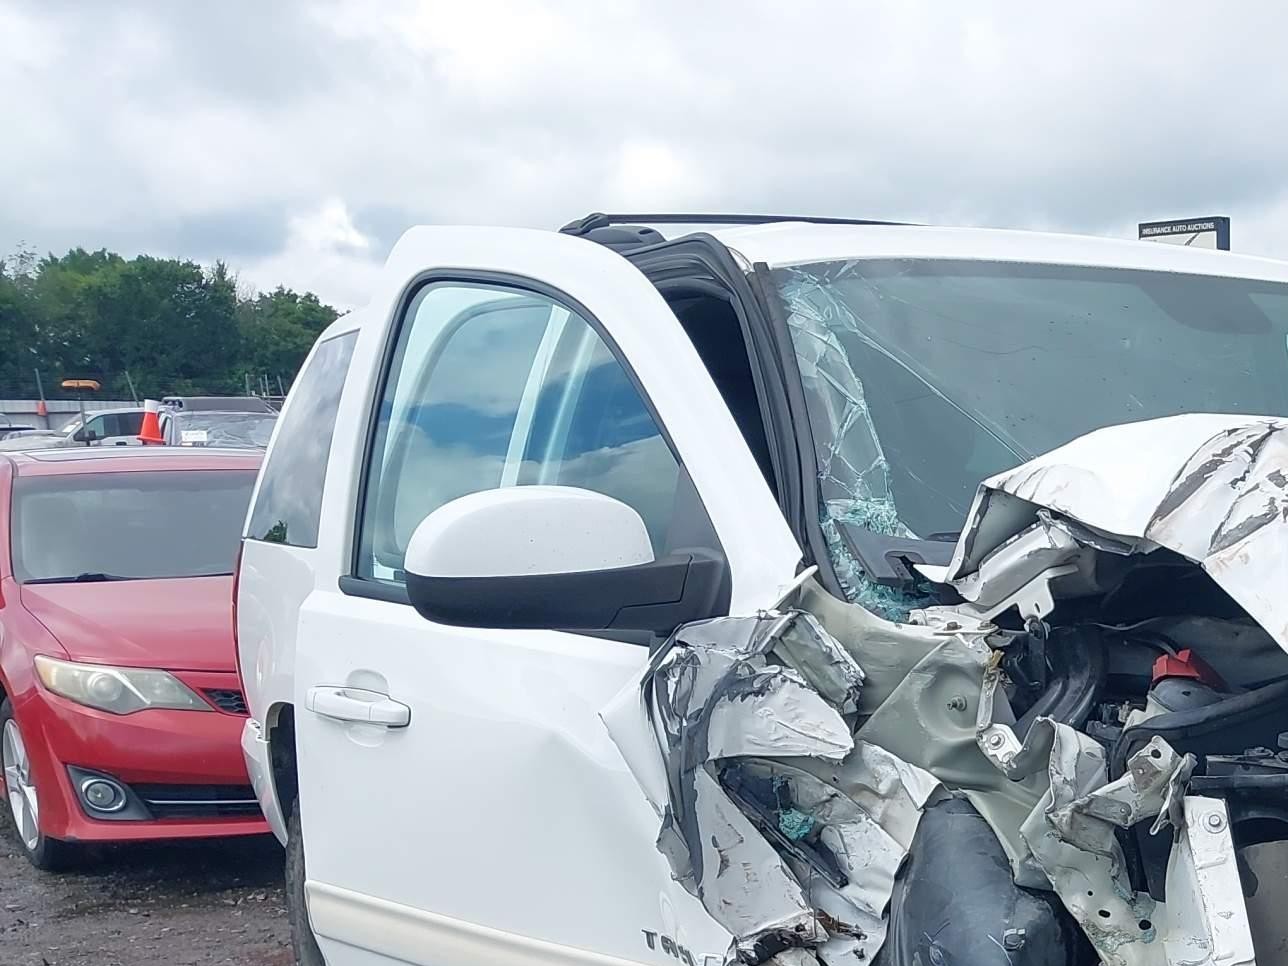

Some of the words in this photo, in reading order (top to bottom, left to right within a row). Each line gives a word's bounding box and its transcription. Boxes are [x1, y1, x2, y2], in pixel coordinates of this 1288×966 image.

[1142, 227, 1171, 235] INSURANCE
[1173, 224, 1187, 232] AUTO
[1188, 222, 1215, 230] AUCTIONS
